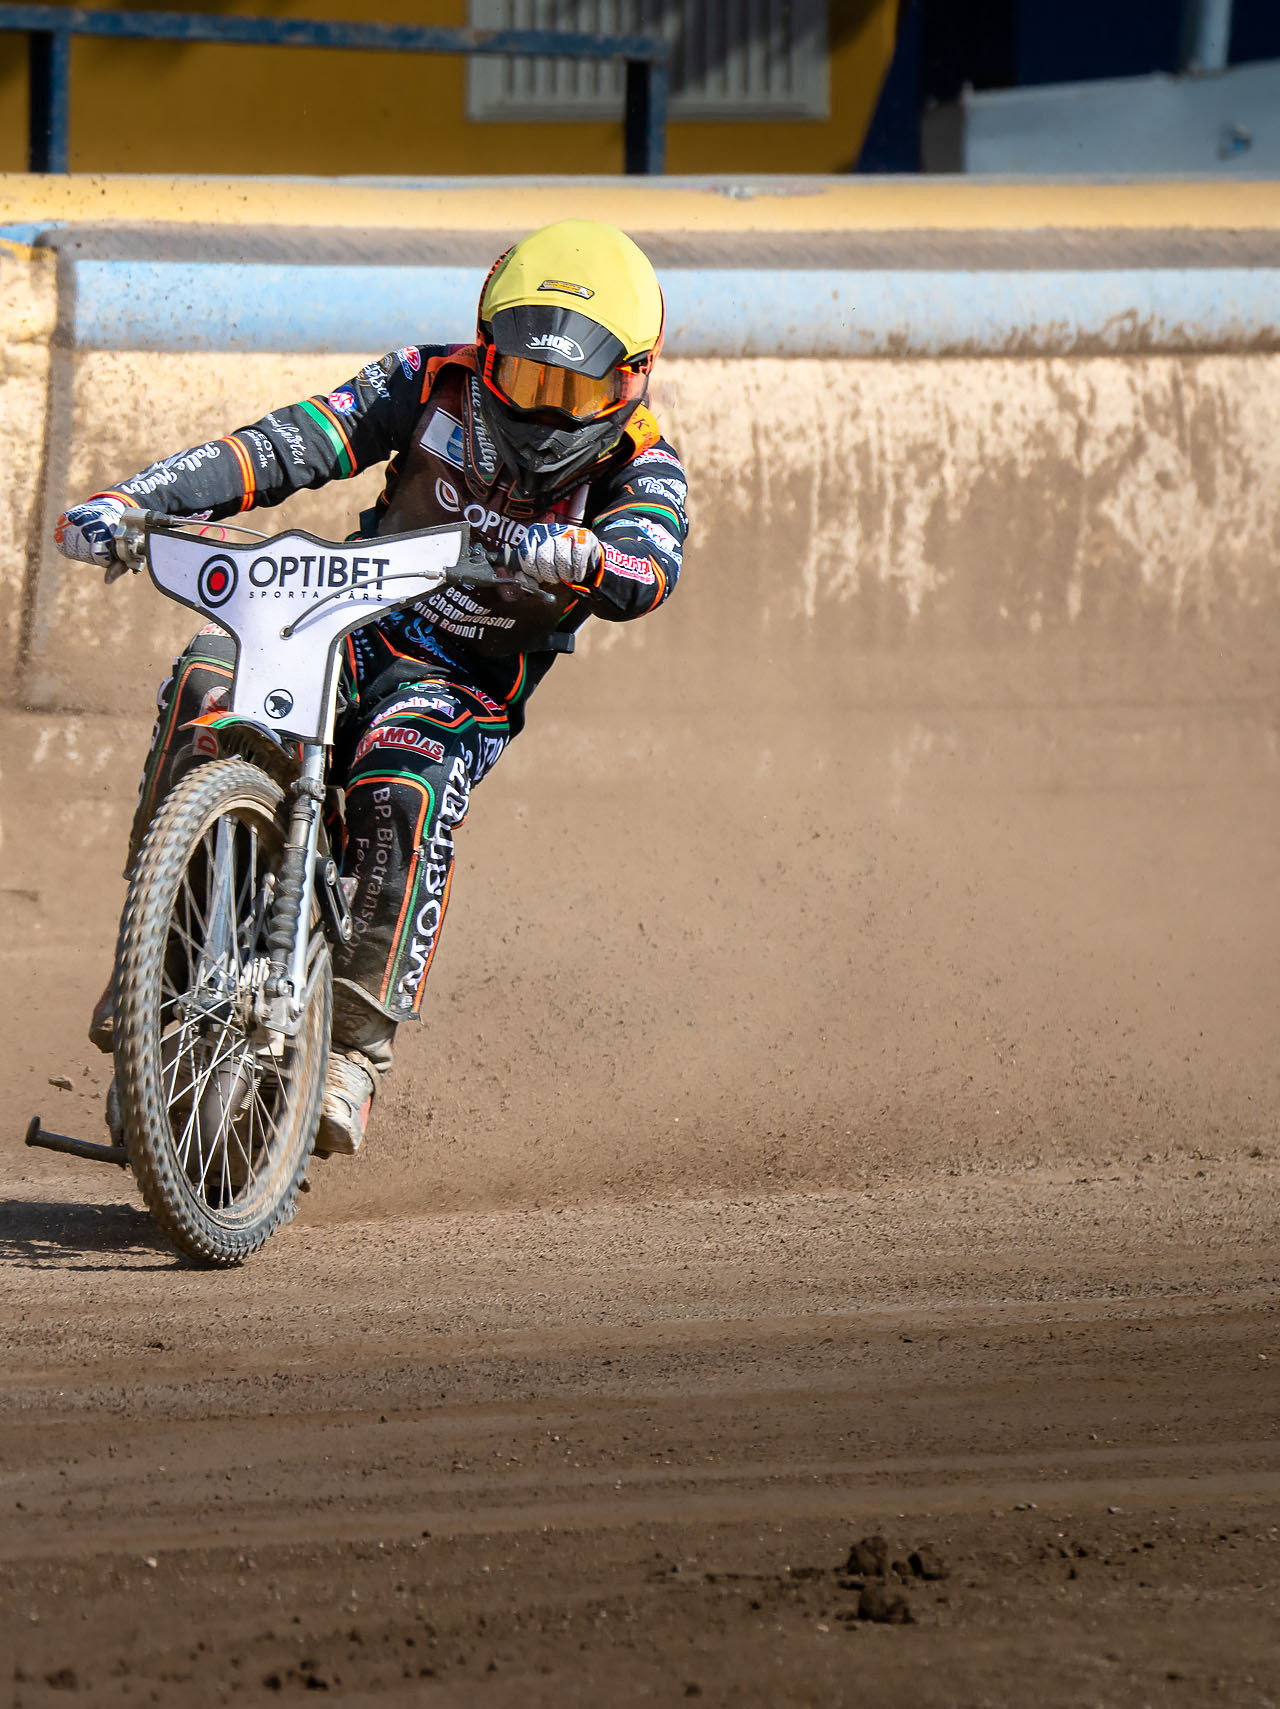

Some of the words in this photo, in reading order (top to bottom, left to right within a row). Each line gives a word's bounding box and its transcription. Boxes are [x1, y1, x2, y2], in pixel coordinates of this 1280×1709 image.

[463, 504, 529, 546] OPTIB
[249, 556, 390, 590] OPTIBET
[249, 591, 319, 599] SPORTA
[445, 586, 492, 615] eedway
[440, 619, 477, 639] Round
[478, 627, 485, 640] 1
[421, 737, 444, 756] A/S
[373, 787, 392, 820] BP.
